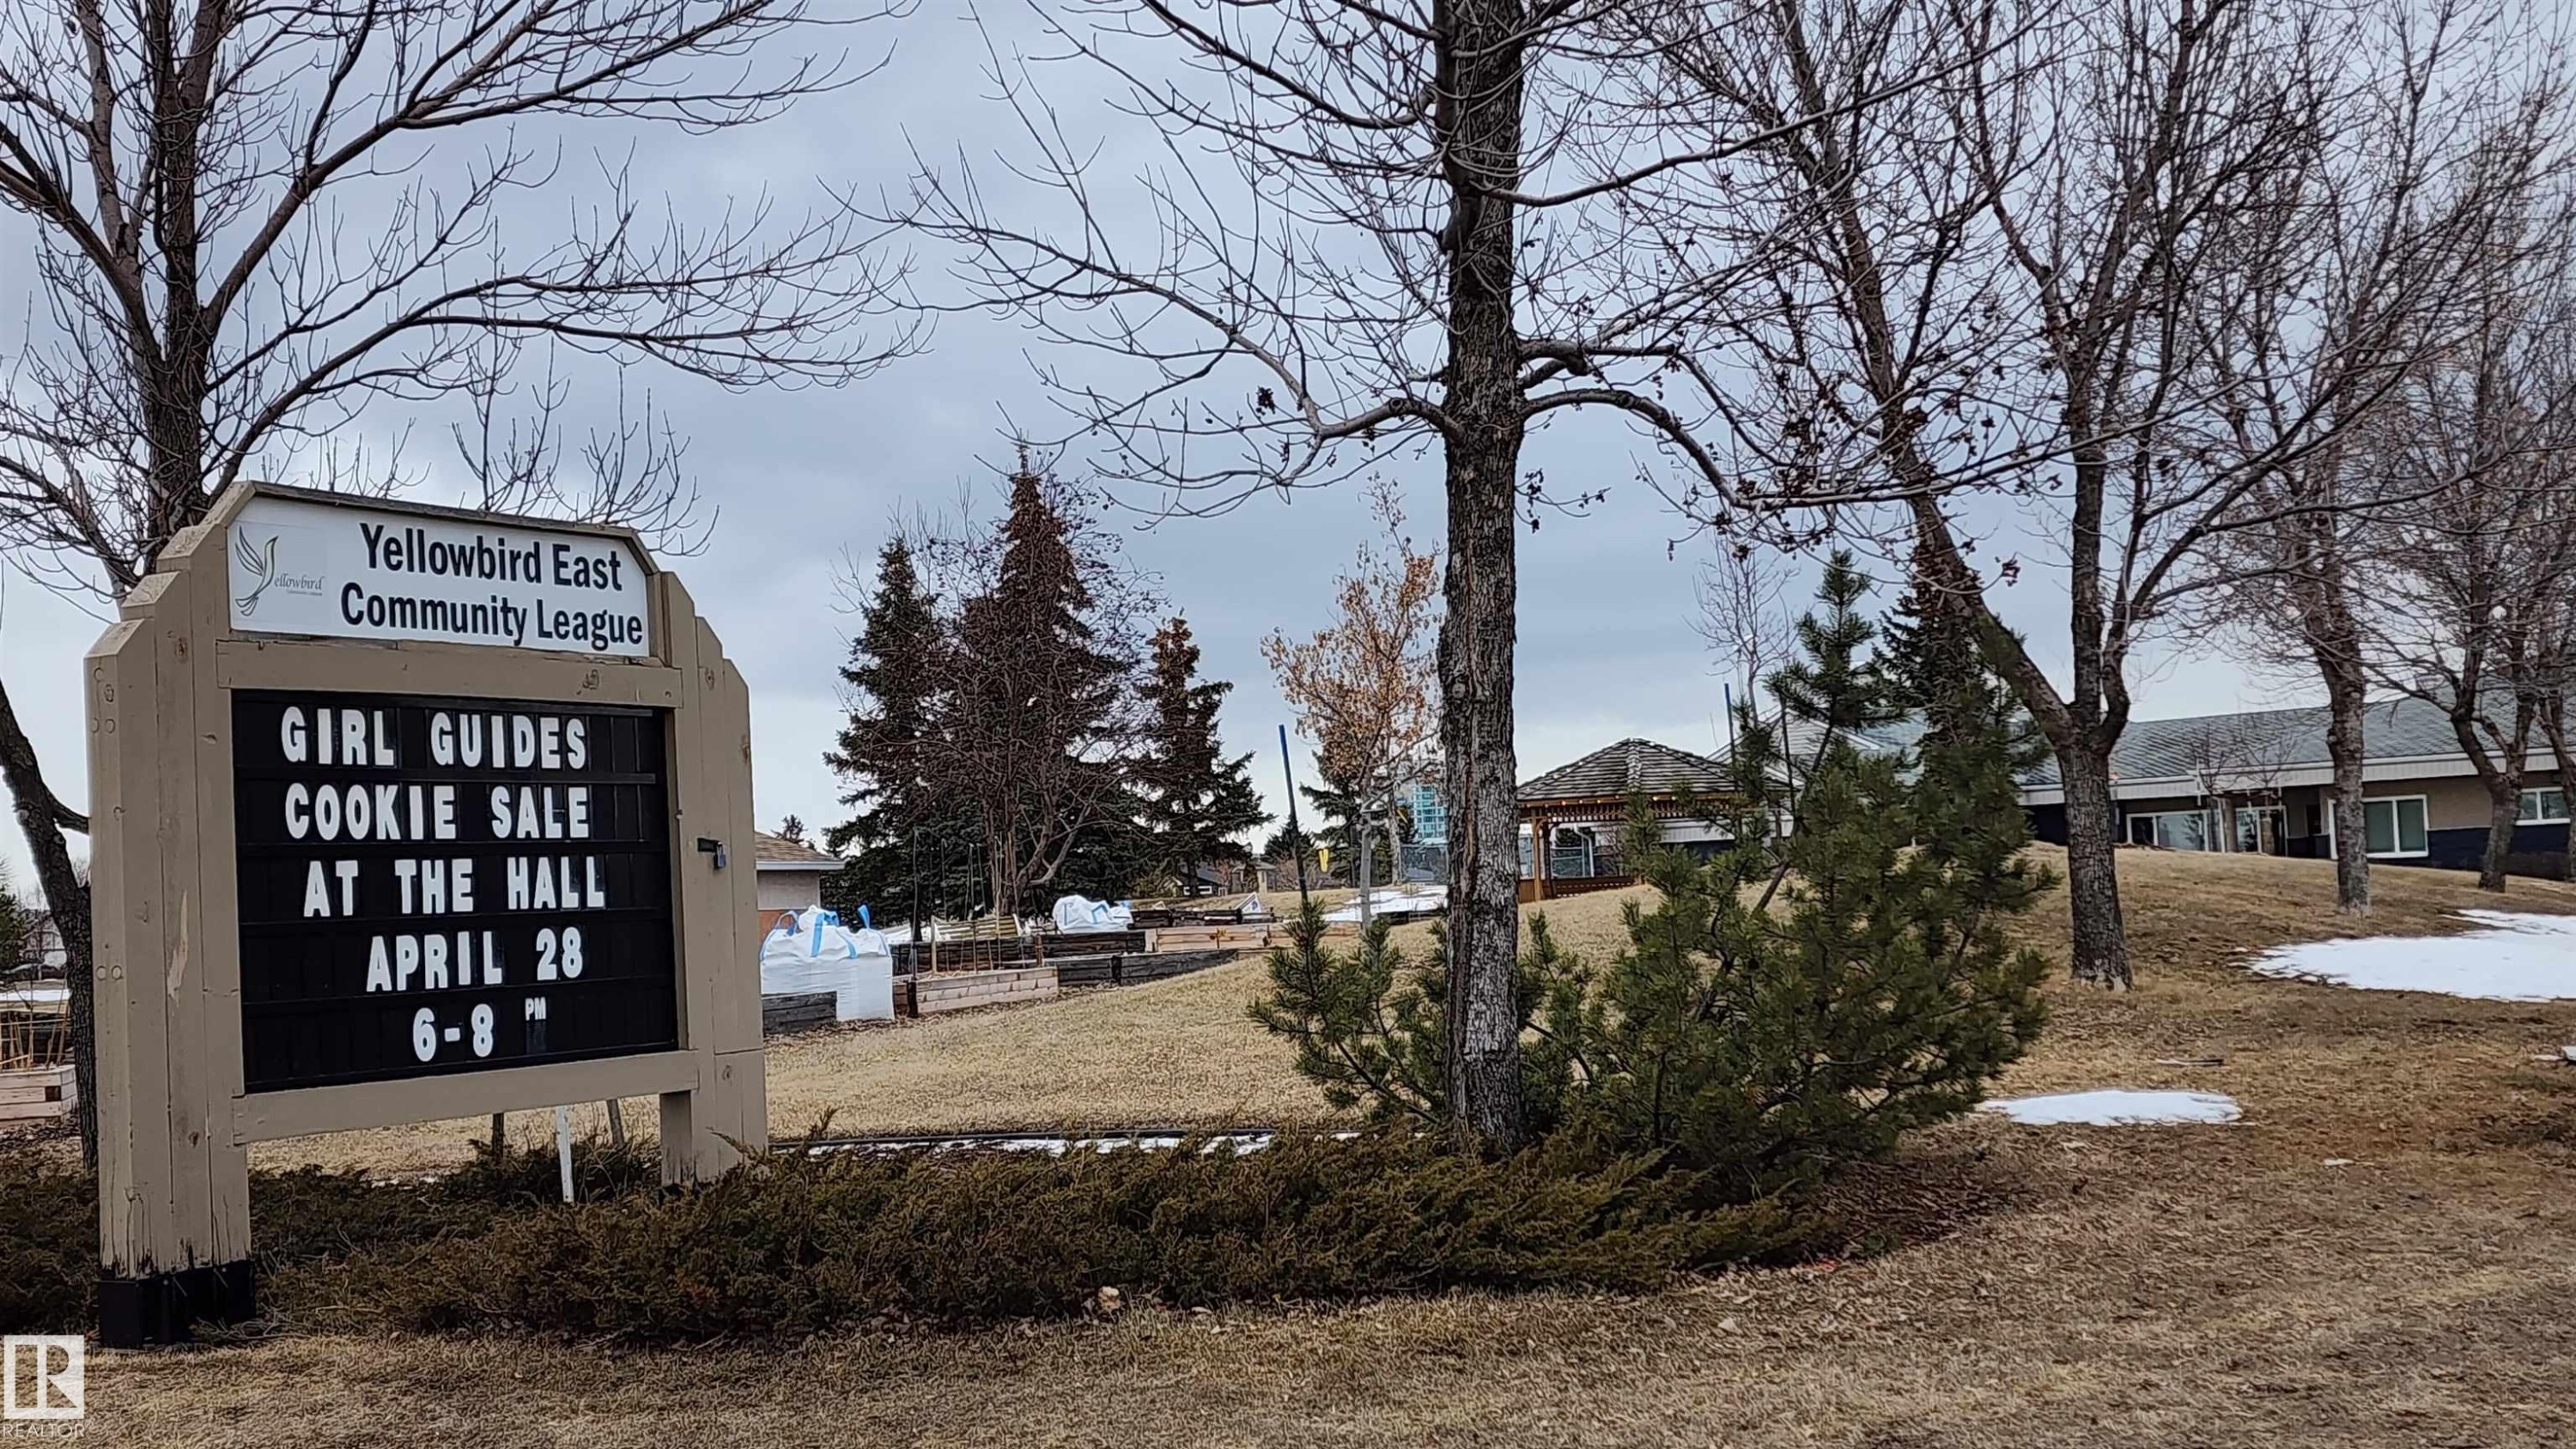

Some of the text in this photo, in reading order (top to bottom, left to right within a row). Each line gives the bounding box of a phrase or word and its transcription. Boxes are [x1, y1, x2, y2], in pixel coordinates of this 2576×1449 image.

[359, 523, 623, 591] Yellowbird East
[341, 582, 644, 651] Community League
[281, 706, 586, 769] GIRL GUIDES
[284, 782, 590, 841] COOKIE SALE
[303, 856, 605, 918] AT THE HALL
[366, 926, 583, 992] APRIL 28
[412, 997, 547, 1063] 6-8 PM
